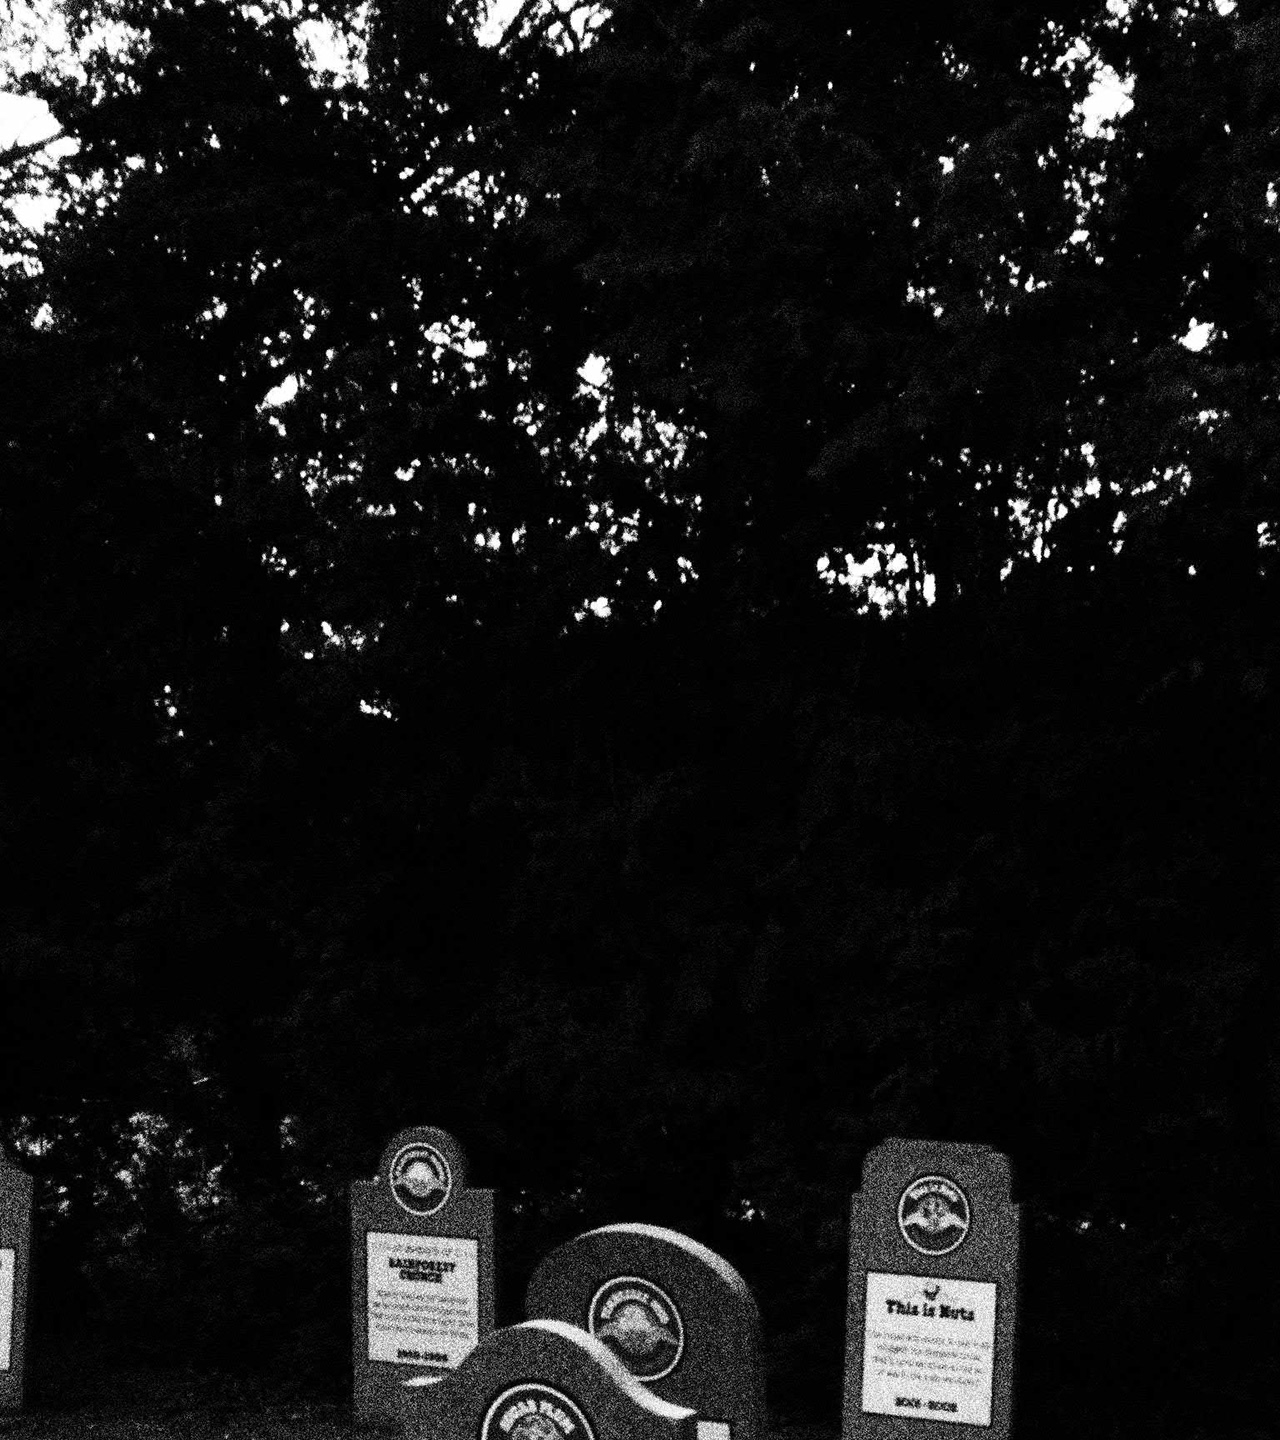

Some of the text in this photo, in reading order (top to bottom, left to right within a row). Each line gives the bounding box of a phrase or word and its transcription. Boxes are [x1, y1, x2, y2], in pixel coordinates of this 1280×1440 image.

[885, 1298, 974, 1321] This is Nuts
